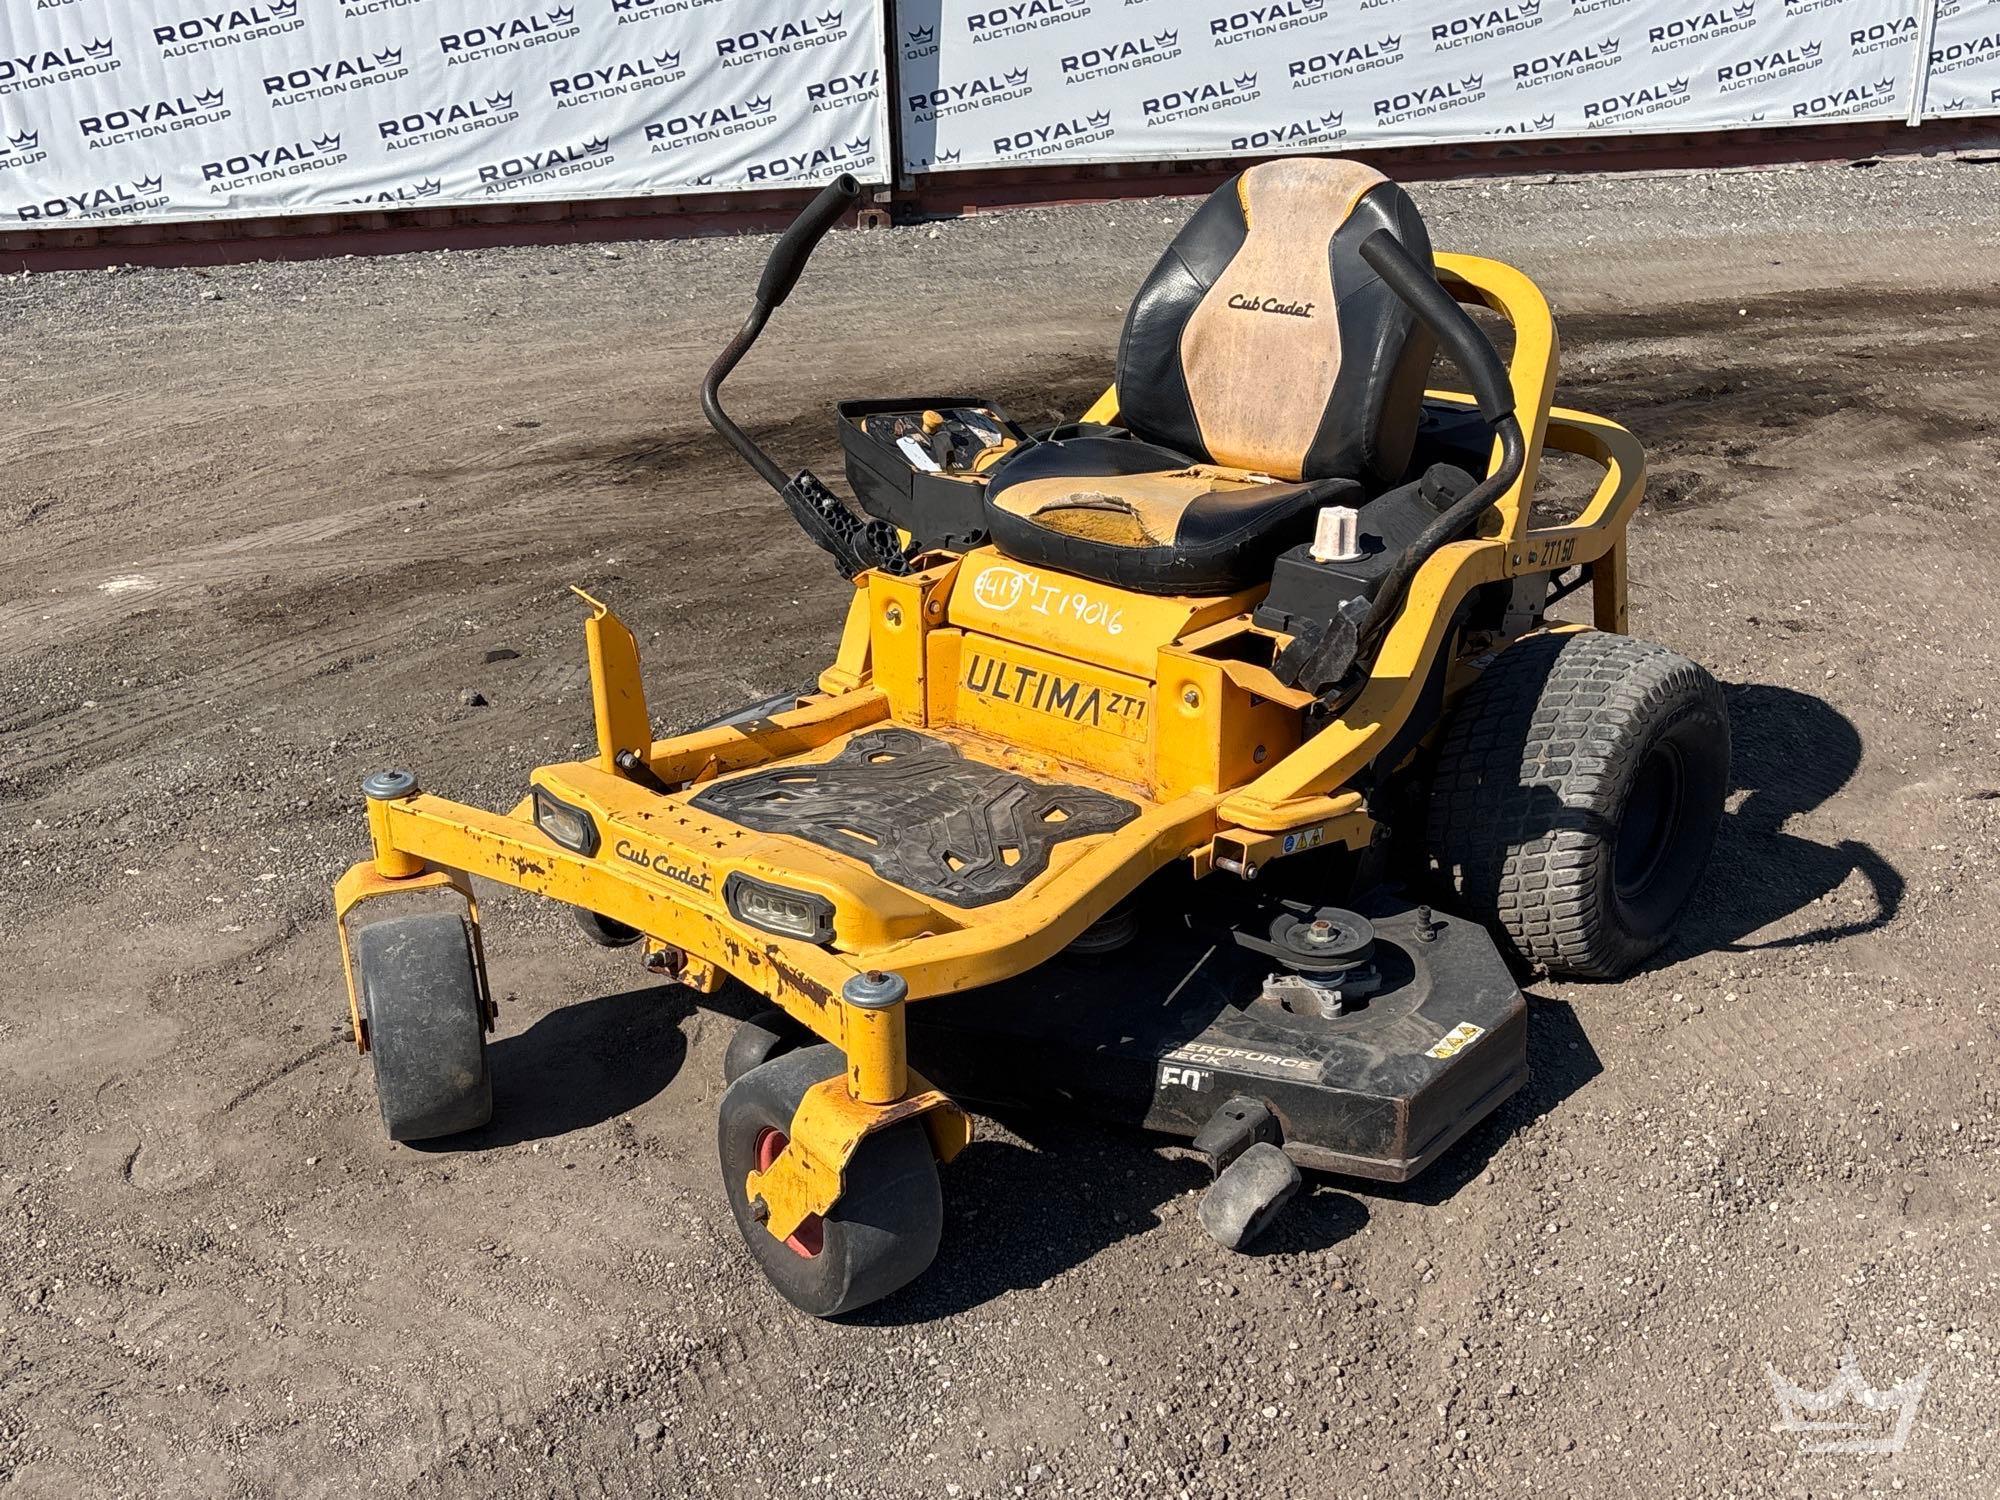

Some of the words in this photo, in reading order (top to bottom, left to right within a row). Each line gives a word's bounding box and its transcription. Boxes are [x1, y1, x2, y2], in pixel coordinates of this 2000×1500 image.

[153, 7, 270, 45] ROYAL
[617, 0, 689, 25] AUCTION
[967, 0, 1063, 32] ROYAL
[972, 20, 1038, 44] AUCTION
[1040, 7, 1092, 27] GROUP
[1210, 1, 1302, 36] ROYAL
[1214, 24, 1277, 47] AUCTION
[1279, 11, 1329, 31] GROUP
[1431, 7, 1519, 41] ROYAL
[1649, 9, 1733, 43] ROYAL
[162, 33, 241, 59] AUCTION
[244, 19, 305, 41] GROUP
[440, 15, 549, 53] ROYAL
[447, 41, 521, 67] AUCTION
[523, 26, 581, 48] GROUP
[716, 19, 818, 57] ROYAL
[1434, 29, 1494, 53] AUCTION
[1496, 17, 1543, 36] GROUP
[1651, 31, 1709, 55] AUCTION
[1711, 19, 1757, 38] GROUP
[1850, 16, 1918, 46] ROYA
[1852, 33, 1908, 57] AUCTION
[0, 47, 85, 80] OYAL
[721, 44, 791, 69] AUCTION
[793, 30, 848, 51] GROUP
[1061, 38, 1156, 73] ROYAL
[1065, 61, 1130, 85] AUCTION
[1131, 48, 1182, 68] GROUP
[1288, 43, 1379, 78] ROYAL
[1512, 46, 1598, 80] ROYAL
[1717, 49, 1800, 83] ROYAL
[1930, 55, 1984, 76] AUCTION
[0, 74, 55, 95] CTION
[58, 59, 121, 82] GROUP
[263, 56, 376, 95] ROYAL
[271, 82, 347, 108] AUCTION
[350, 68, 409, 90] GROUP
[549, 59, 656, 97] ROYAL
[1292, 66, 1354, 90] AUCTION
[1356, 53, 1405, 73] GROUP
[1515, 68, 1574, 91] AUCTION
[1576, 55, 1623, 74] GROUP
[1719, 71, 1777, 94] AUCTION
[1778, 58, 1823, 78] GROUP
[556, 84, 628, 110] AUCTION
[630, 70, 686, 92] GROUP
[811, 88, 879, 114] AUCTION
[908, 76, 1005, 112] ROYAL
[913, 100, 979, 124] AUCTION
[981, 86, 1033, 107] GROUP
[1142, 80, 1235, 116] ROYAL
[1373, 82, 1462, 116] ROYAL
[1583, 85, 1668, 119] ROYAL
[1792, 85, 1873, 118] ROYAL
[1852, 94, 1896, 113] GROUP
[79, 97, 197, 136] ROYAL
[378, 100, 488, 139] ROYAL
[644, 104, 748, 142] ROYAL
[1147, 104, 1209, 128] AUCTION
[1211, 90, 1261, 110] GROUP
[1377, 104, 1437, 128] AUCTION
[1438, 91, 1486, 111] GROUP
[1586, 107, 1644, 130] AUCTION
[1646, 94, 1691, 114] GROUP
[88, 124, 167, 150] AUCTION
[170, 109, 232, 131] GROUP
[385, 125, 460, 151] AUCTION
[462, 110, 520, 133] GROUP
[650, 128, 721, 154] AUCTION
[722, 114, 778, 136] GROUP
[993, 119, 1088, 154] ROYAL
[1064, 128, 1115, 149] GROUP
[1231, 119, 1322, 150] ROYAL
[0, 151, 47, 170] ROUP
[201, 143, 315, 181] ROYAL
[209, 168, 286, 194] AUCTION
[288, 153, 348, 176] GROUP
[478, 145, 585, 183] ROYAL
[485, 169, 557, 196] AUCTION
[559, 155, 615, 178] GROUP
[747, 145, 847, 183] ROYAL
[822, 156, 876, 178] GROUP
[17, 184, 135, 221] ROYAL
[108, 195, 170, 217] GROUP
[1228, 294, 1260, 311] Cub
[1261, 298, 1315, 318] Cadet
[967, 654, 1101, 727] ULTIMA
[1106, 692, 1147, 720] ZT1
[615, 840, 651, 868] Cub
[652, 855, 712, 894] Cadet
